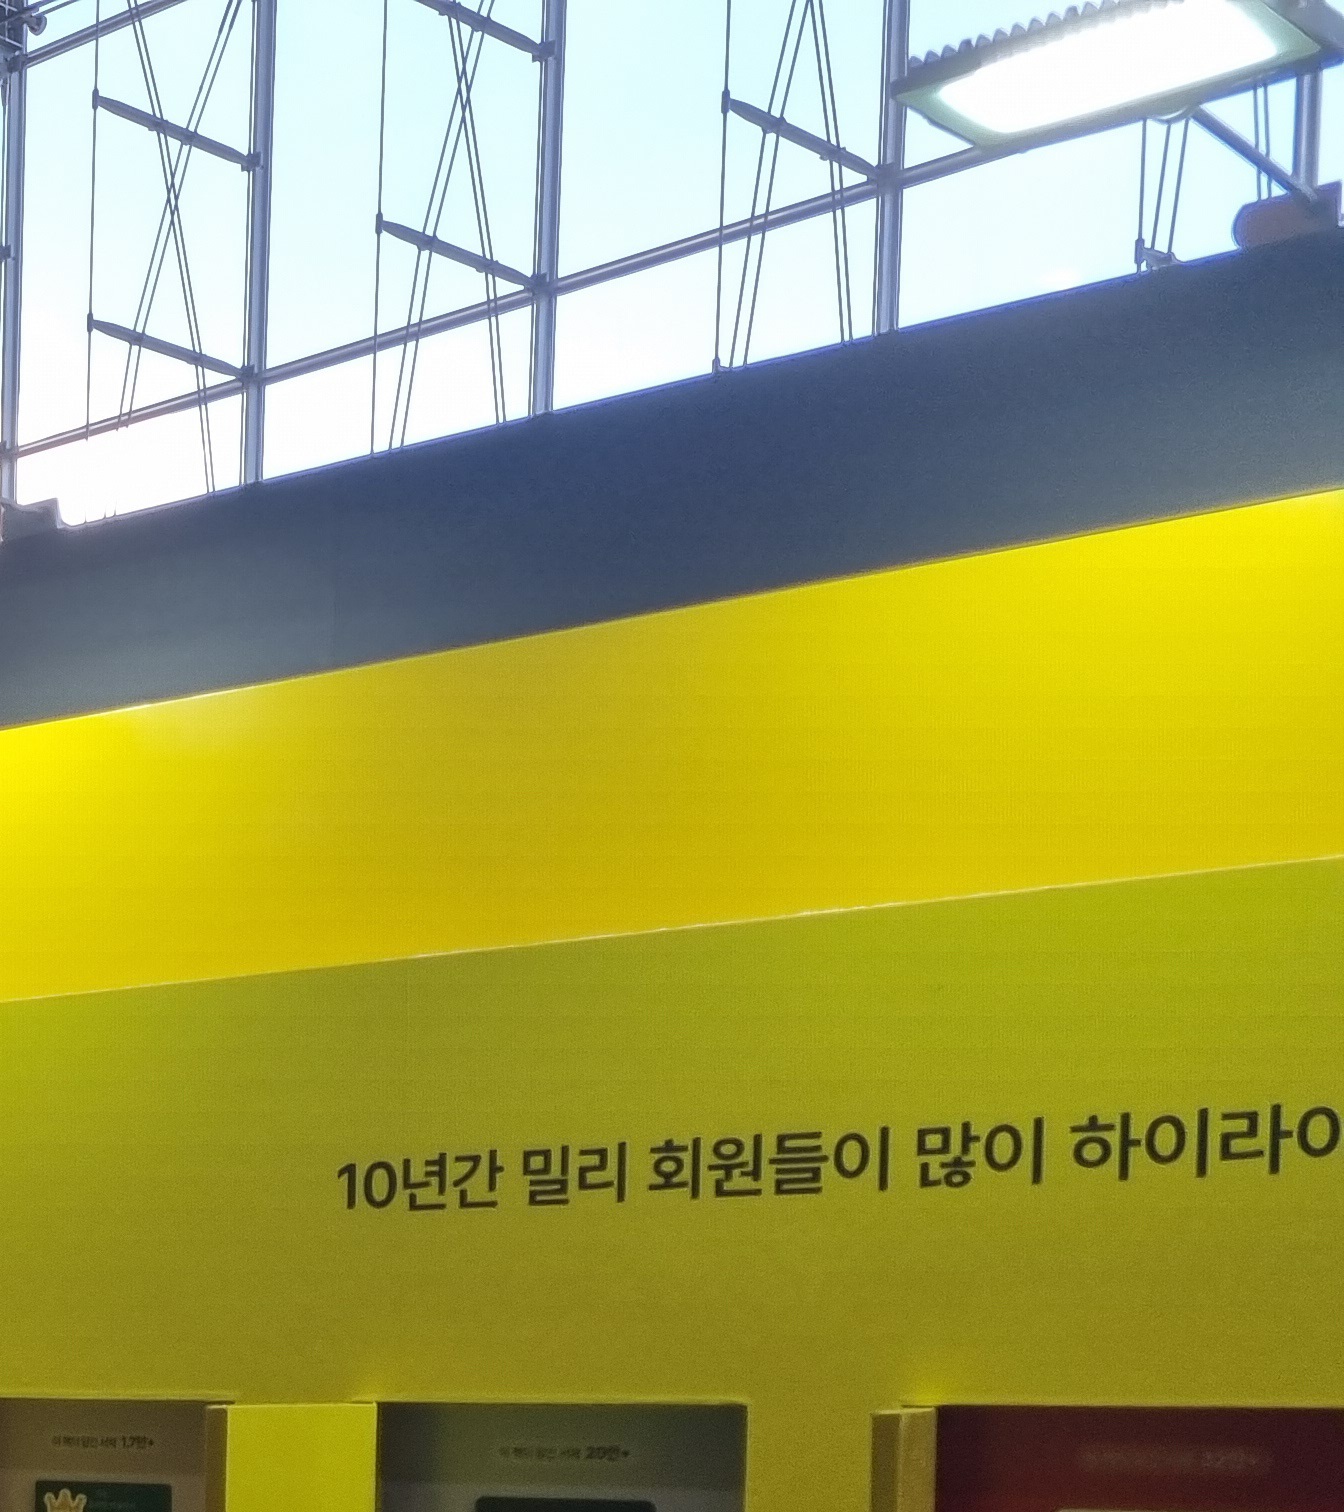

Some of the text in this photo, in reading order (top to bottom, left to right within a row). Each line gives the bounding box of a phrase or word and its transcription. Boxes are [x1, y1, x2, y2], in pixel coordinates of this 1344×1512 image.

[337, 1149, 503, 1210] 10년간
[522, 1142, 628, 1206] 밀리
[648, 1125, 890, 1199] 회원들이
[917, 1116, 1045, 1190] 많이
